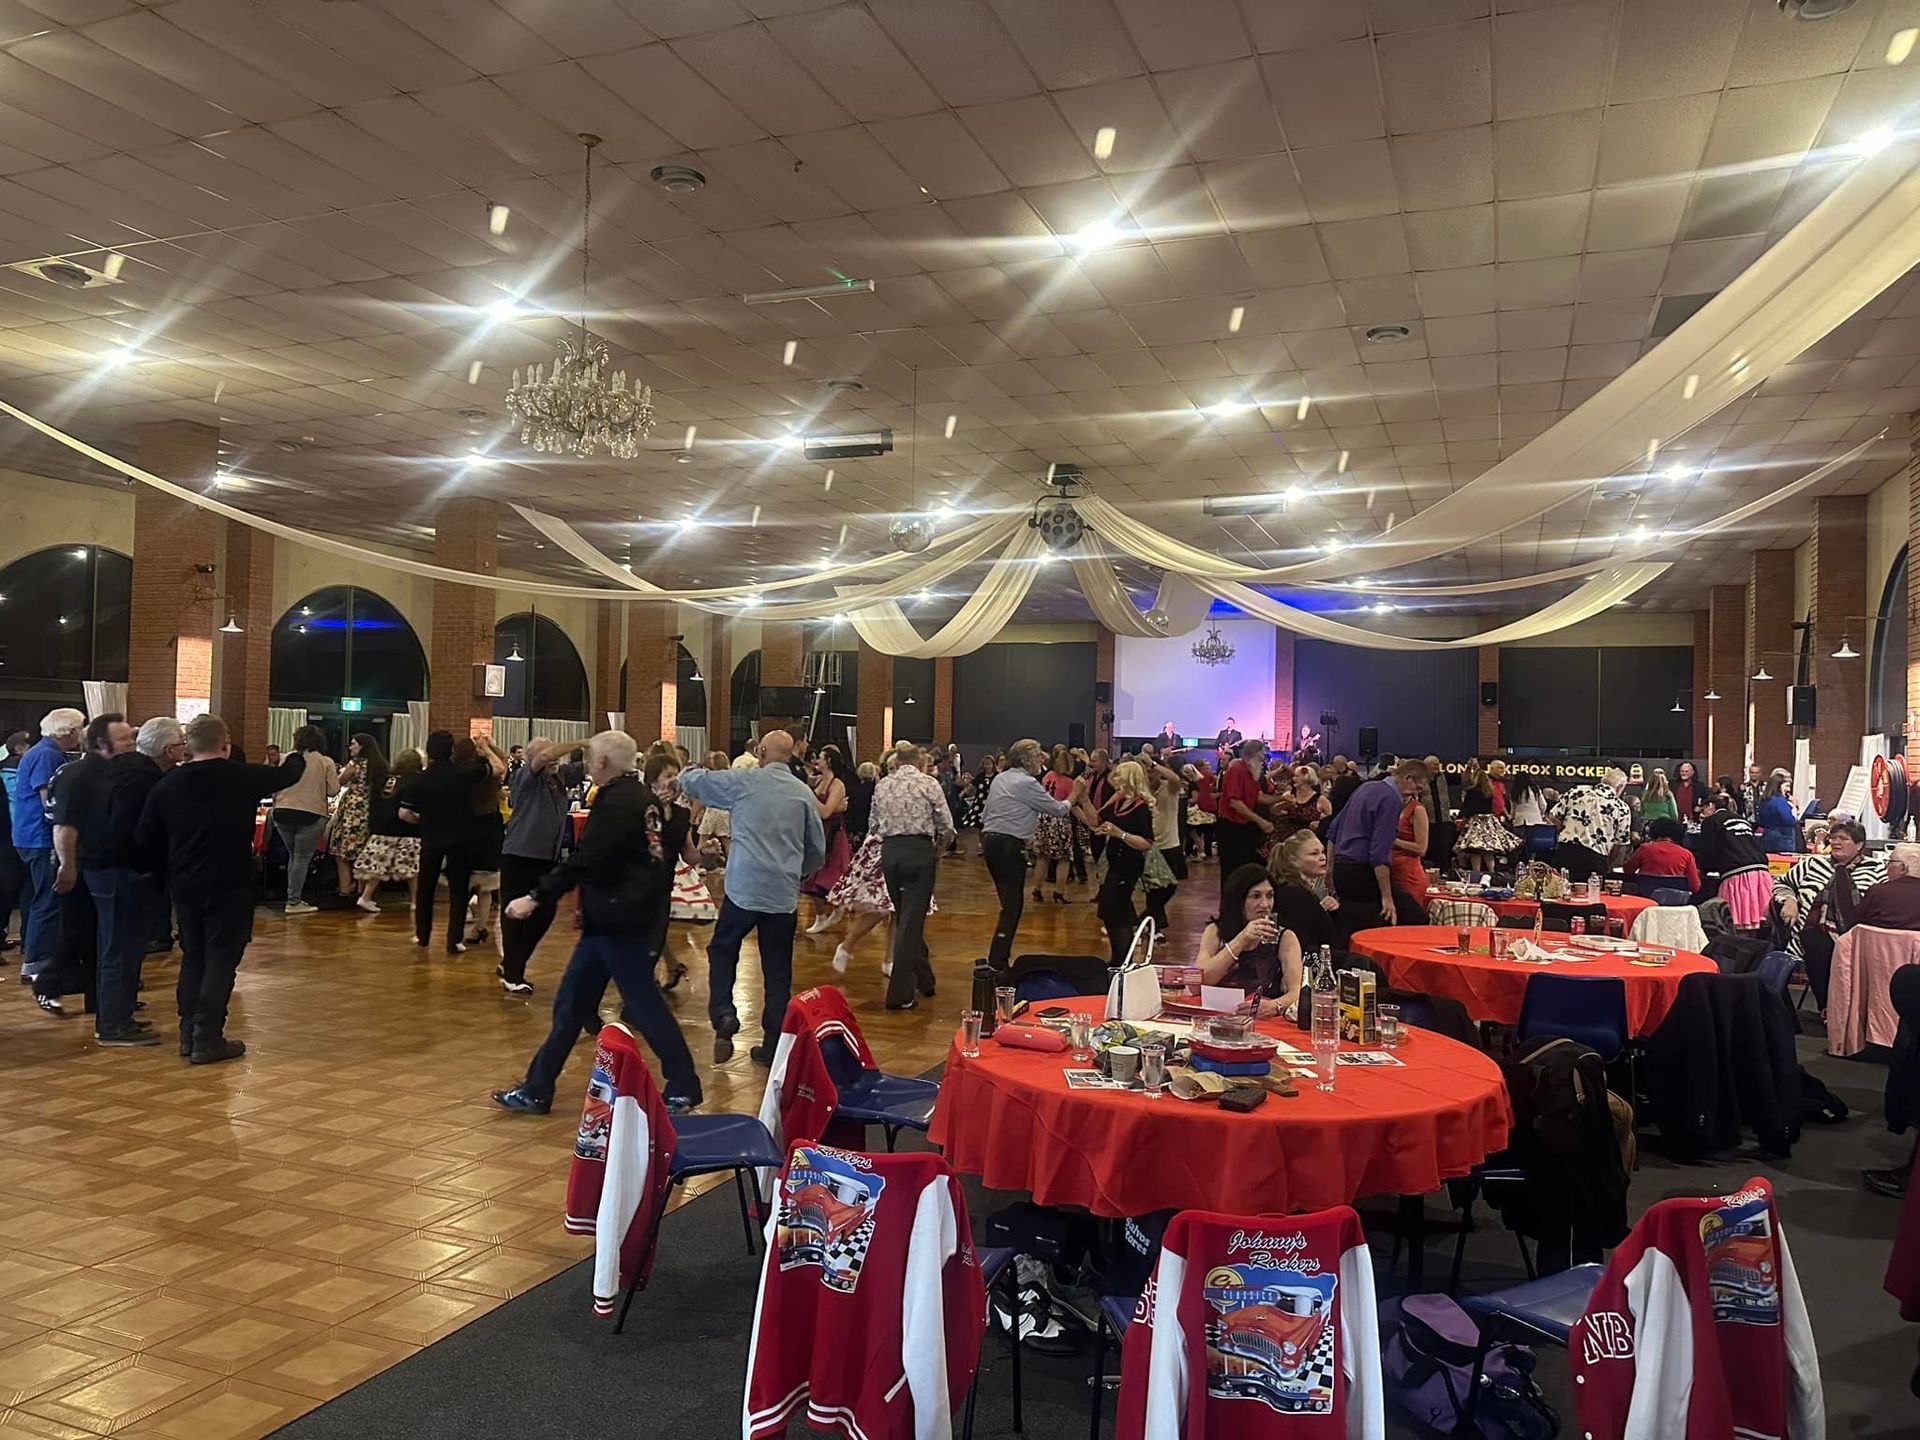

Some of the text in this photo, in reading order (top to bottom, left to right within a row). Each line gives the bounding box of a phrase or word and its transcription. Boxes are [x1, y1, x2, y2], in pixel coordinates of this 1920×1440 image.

[1484, 763, 1551, 776] JKEBOX
[1125, 1216, 1151, 1248] Salvos
[1125, 1226, 1148, 1256] tores
[1227, 1229, 1307, 1254] Johnny's
[1249, 1250, 1321, 1272] Rockers
